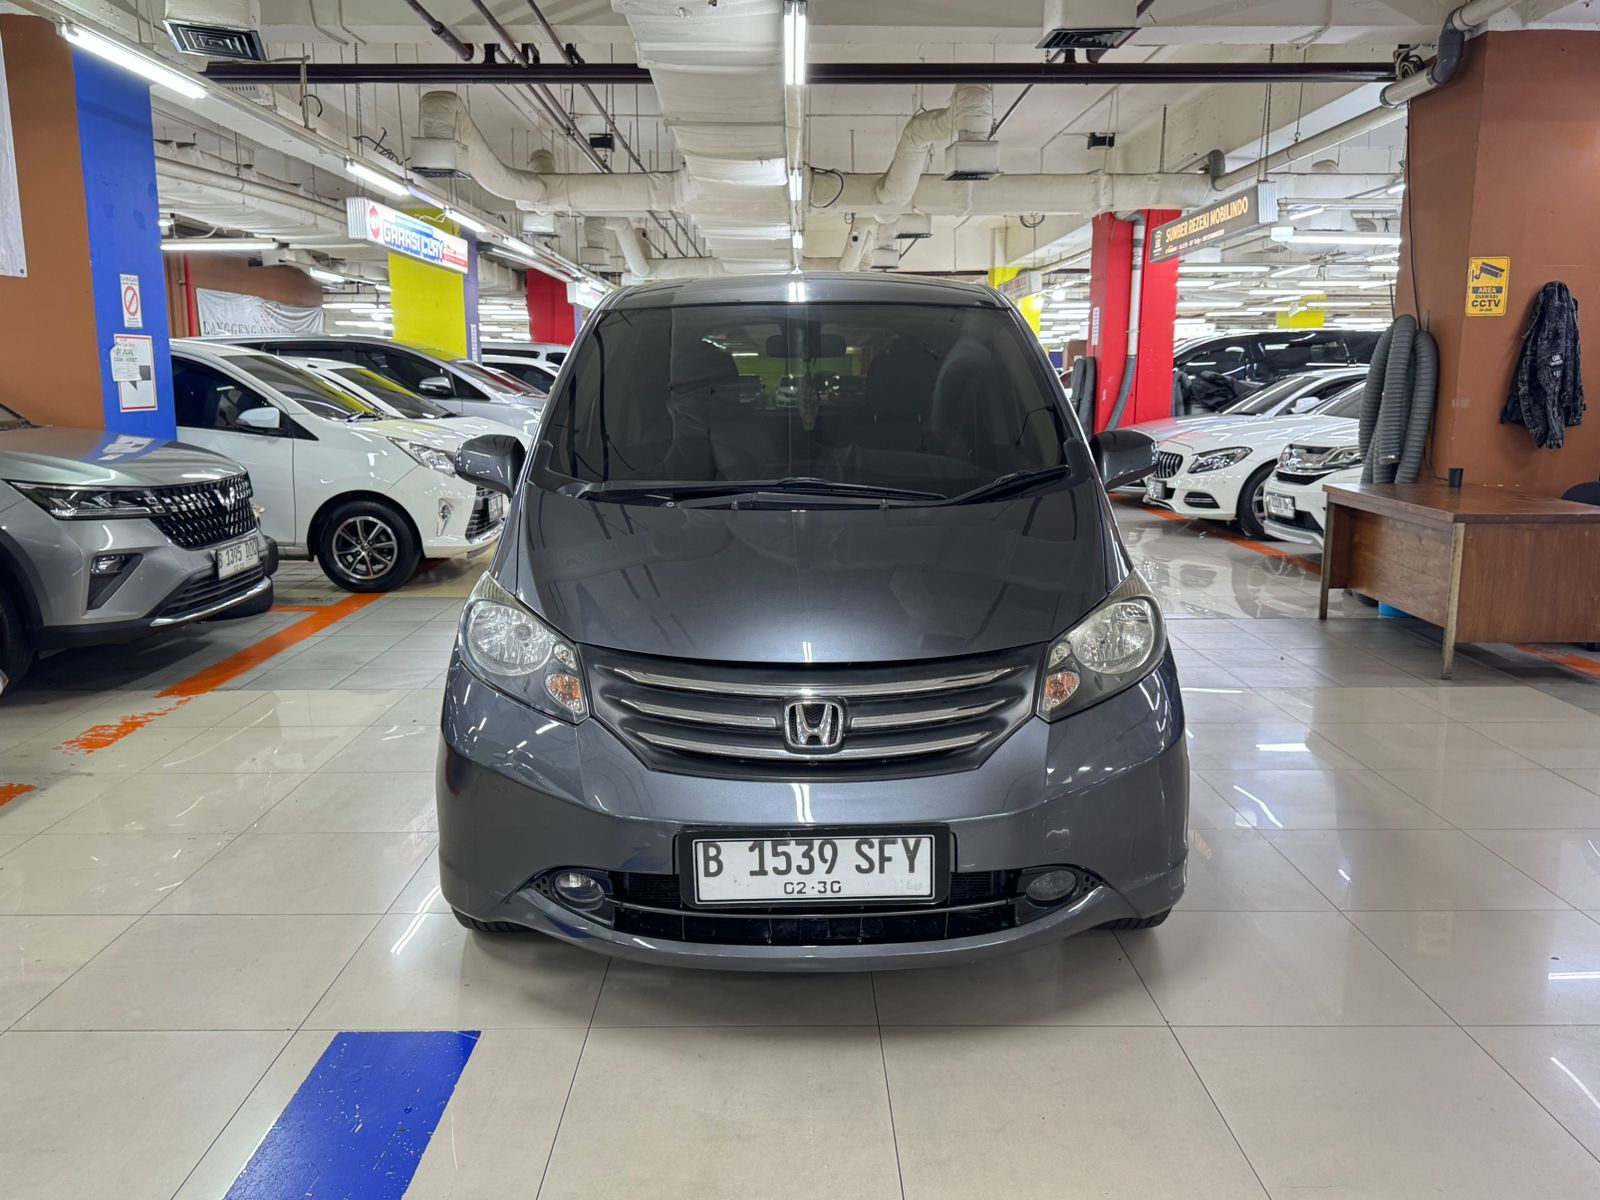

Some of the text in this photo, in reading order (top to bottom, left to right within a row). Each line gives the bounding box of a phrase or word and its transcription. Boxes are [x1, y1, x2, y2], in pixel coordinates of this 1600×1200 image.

[383, 223, 421, 255] GARASI
[1166, 220, 1188, 242] SUMBER
[1189, 212, 1210, 232] REZEKI
[1210, 196, 1248, 226] MOBILINDO
[702, 837, 922, 877] B 1539 SFY
